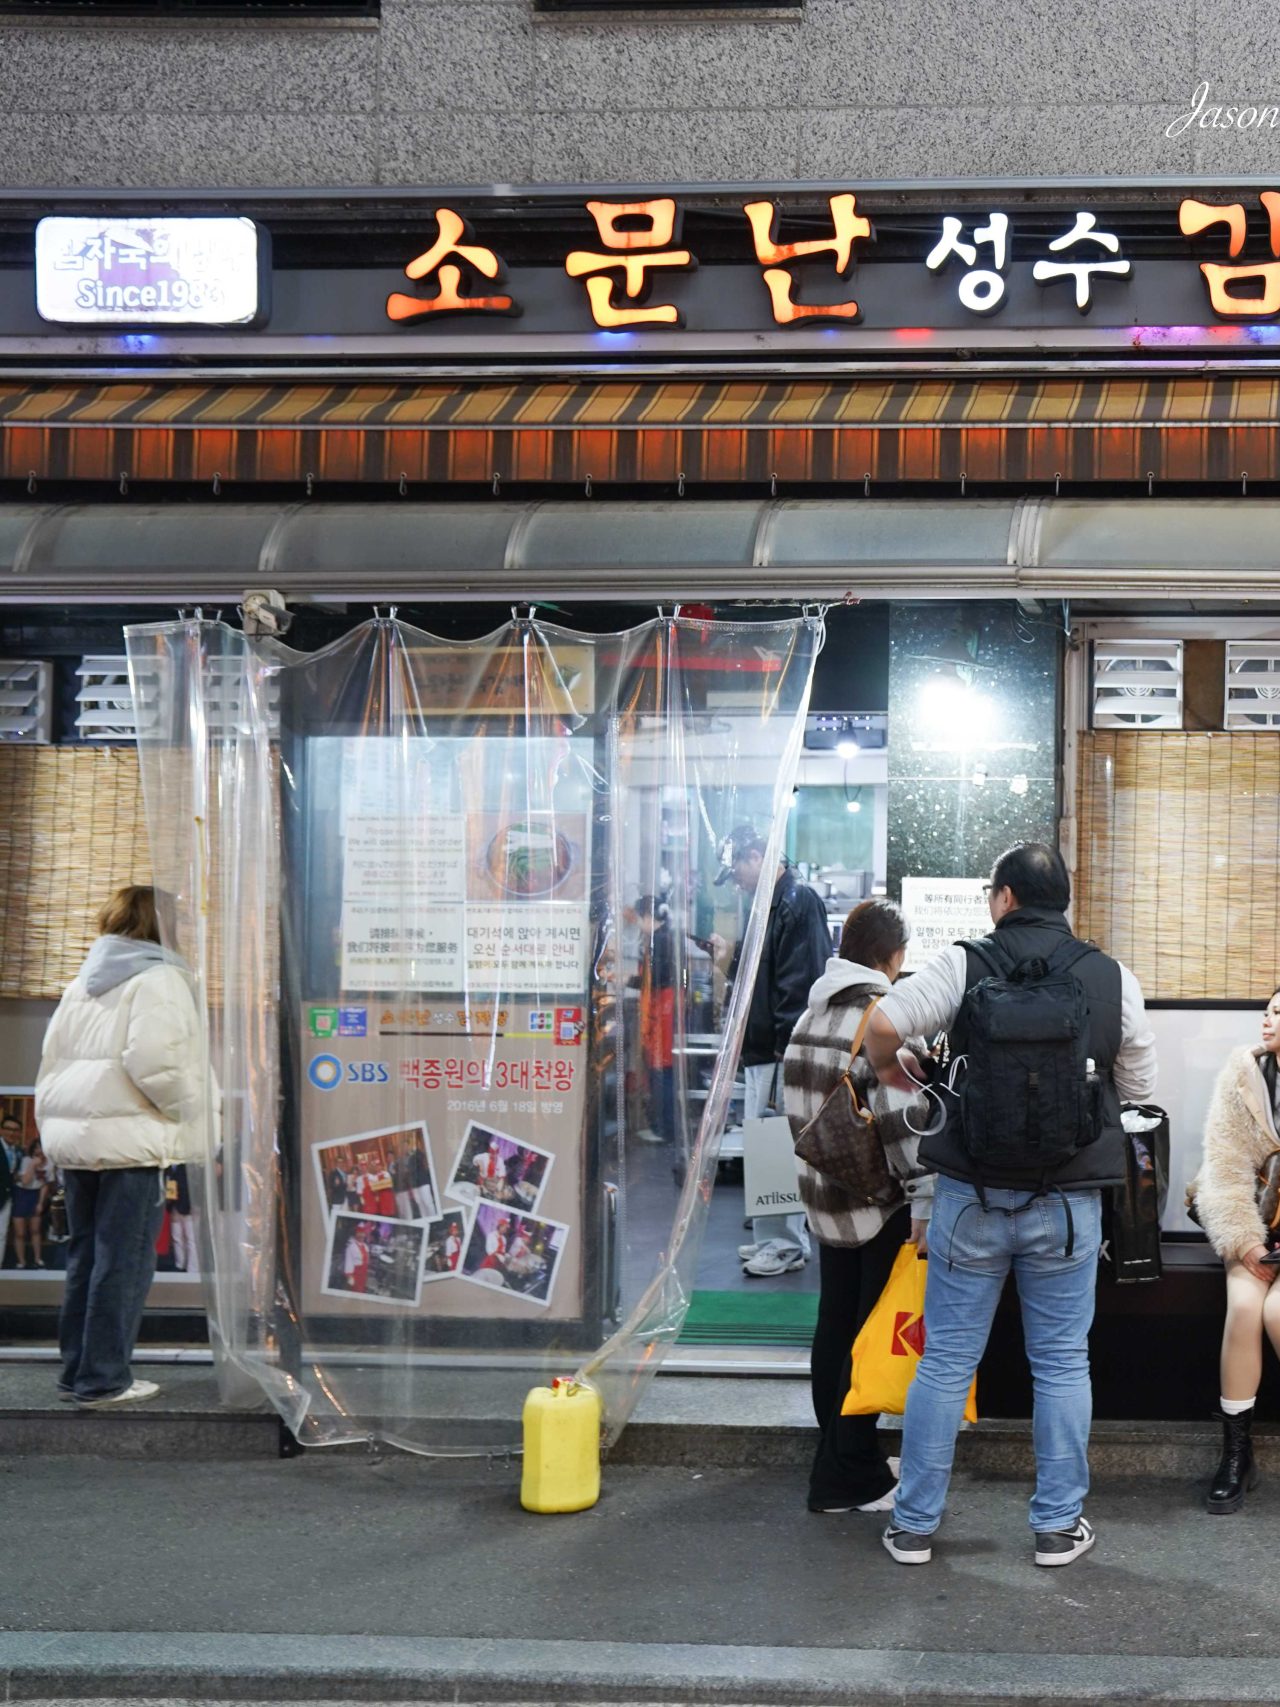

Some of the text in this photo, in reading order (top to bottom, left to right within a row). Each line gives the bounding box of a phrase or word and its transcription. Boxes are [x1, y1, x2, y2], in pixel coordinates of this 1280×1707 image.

[387, 193, 870, 327] 소문난
[926, 211, 1130, 313] 성수
[347, 1058, 575, 1092] SBS 백종원의 3대천왕
